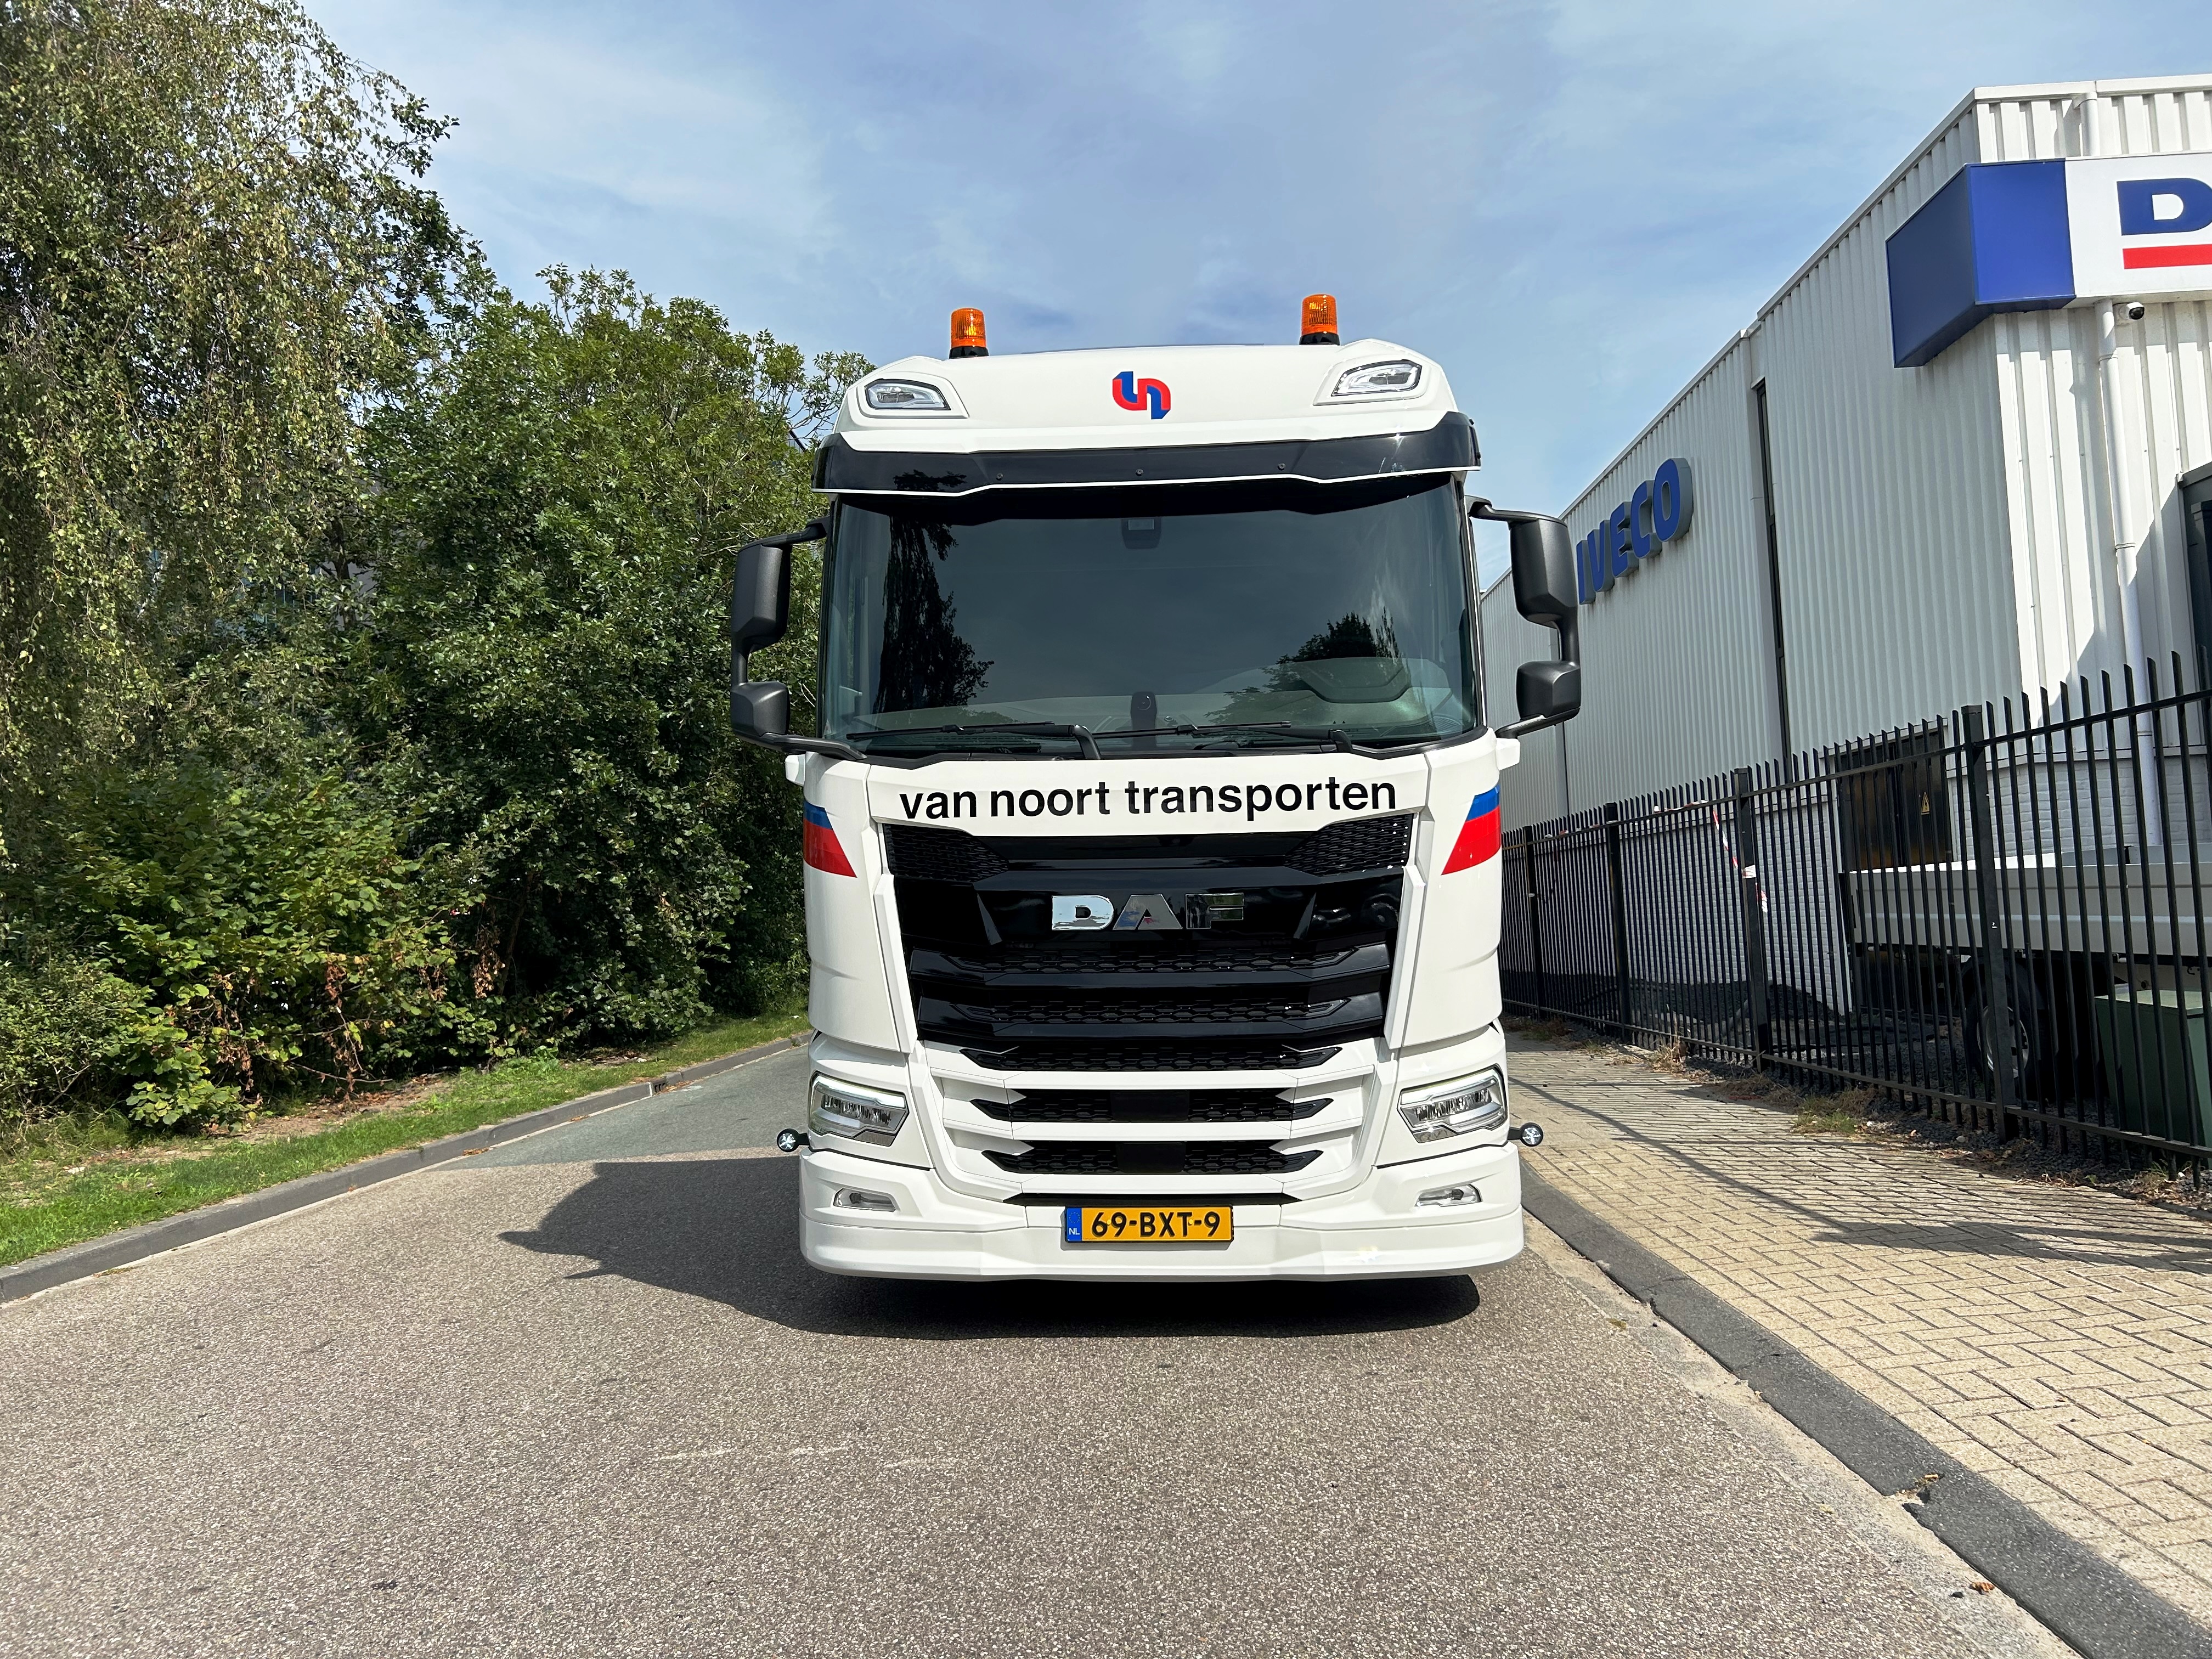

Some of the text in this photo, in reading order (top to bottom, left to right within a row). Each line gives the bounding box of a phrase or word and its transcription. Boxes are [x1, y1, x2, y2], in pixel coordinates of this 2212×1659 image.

[1576, 457, 1694, 605] IVECO
[899, 776, 1396, 821] van noort transporten
[1051, 892, 1245, 931] DAF
[1068, 1211, 1221, 1238] NL 69-BXT-9
